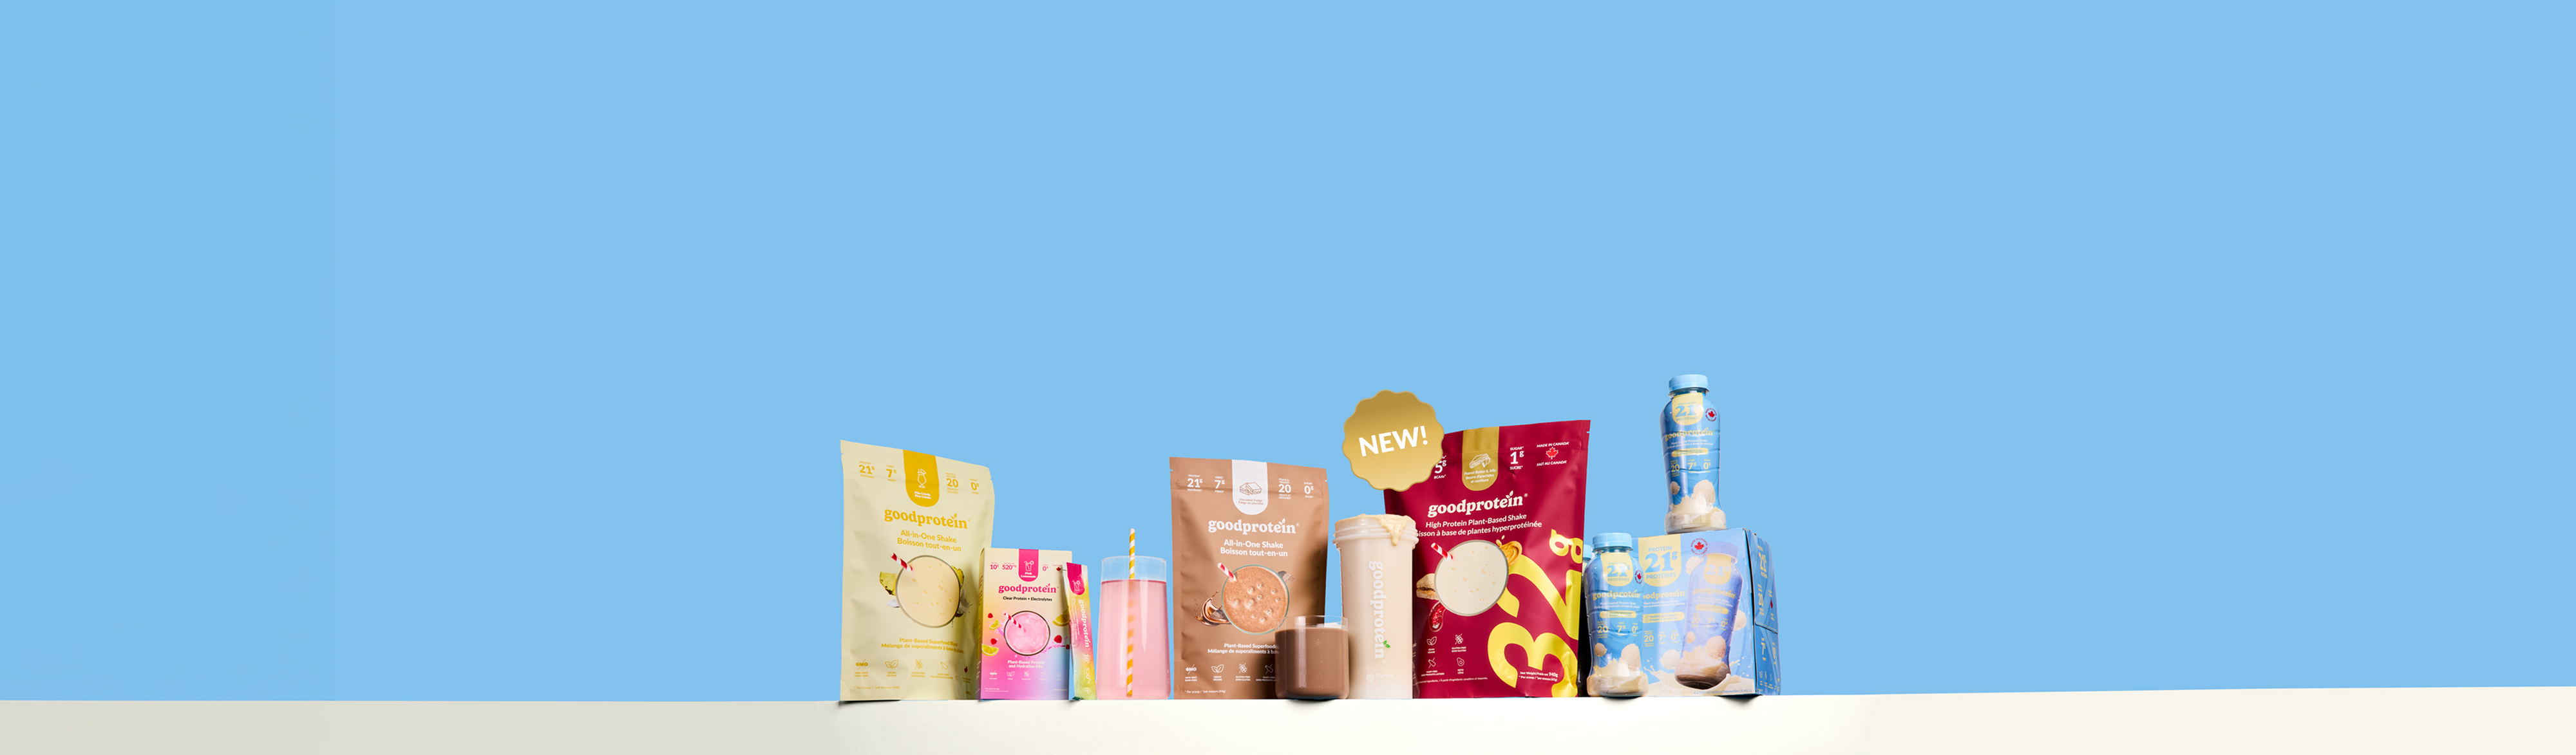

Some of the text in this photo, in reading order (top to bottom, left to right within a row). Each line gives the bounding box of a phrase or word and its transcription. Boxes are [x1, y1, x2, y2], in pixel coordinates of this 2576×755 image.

[1665, 427, 1713, 442] goodprotein
[1510, 451, 1524, 465] 1g
[859, 465, 875, 474] 21g
[1671, 463, 1680, 472] 20
[886, 469, 897, 478] 7g
[947, 478, 958, 487] 20
[971, 482, 980, 490] 0g
[1187, 478, 1203, 488] 21g
[1215, 480, 1225, 489] 7g
[1278, 484, 1291, 493] 20
[1304, 485, 1314, 494] 0g
[1427, 492, 1523, 517] goodprotein
[884, 509, 968, 529] goodprotein
[1468, 516, 1507, 525] Plant-Based
[1208, 519, 1296, 535] goodprotein
[1467, 525, 1491, 536] plantes
[1492, 521, 1542, 533] hyperprotéinée
[900, 530, 957, 543] All-in-One Shake
[897, 537, 961, 552] Boisson tout-en-un
[1224, 539, 1260, 548] All-in-One
[1220, 547, 1247, 555] Boisson
[1645, 552, 1678, 573] 21g
[998, 584, 1056, 594] goodprotein
[1692, 587, 1735, 599] goodprotein
[1593, 590, 1640, 601] goodprotein
[1369, 561, 1387, 659] goodprotein
[1078, 599, 1090, 648] goodprotein
